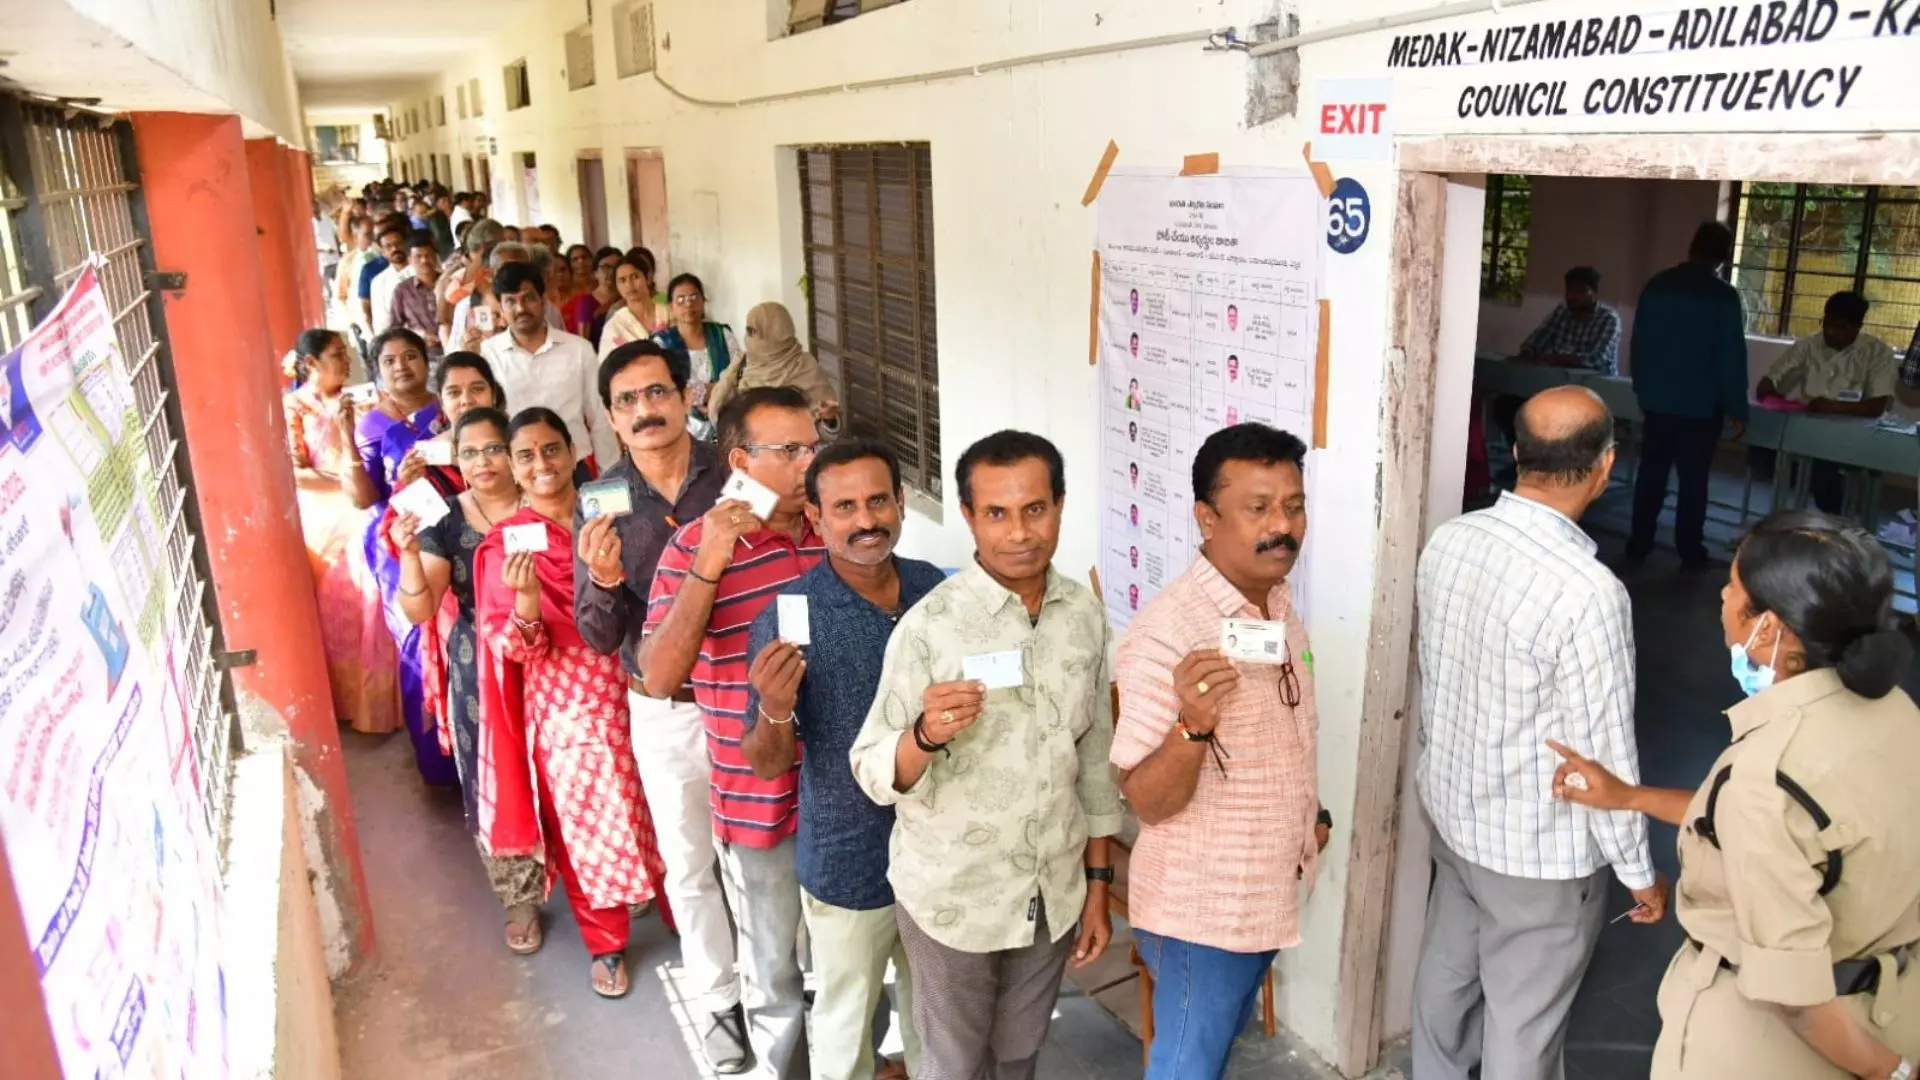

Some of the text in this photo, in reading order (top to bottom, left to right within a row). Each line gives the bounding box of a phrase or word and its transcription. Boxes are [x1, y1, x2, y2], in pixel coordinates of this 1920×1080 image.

[1458, 65, 1862, 118] COUNCIL CONSTITUENCY
[1320, 104, 1387, 134] EXIT
[1327, 197, 1365, 237] 65
